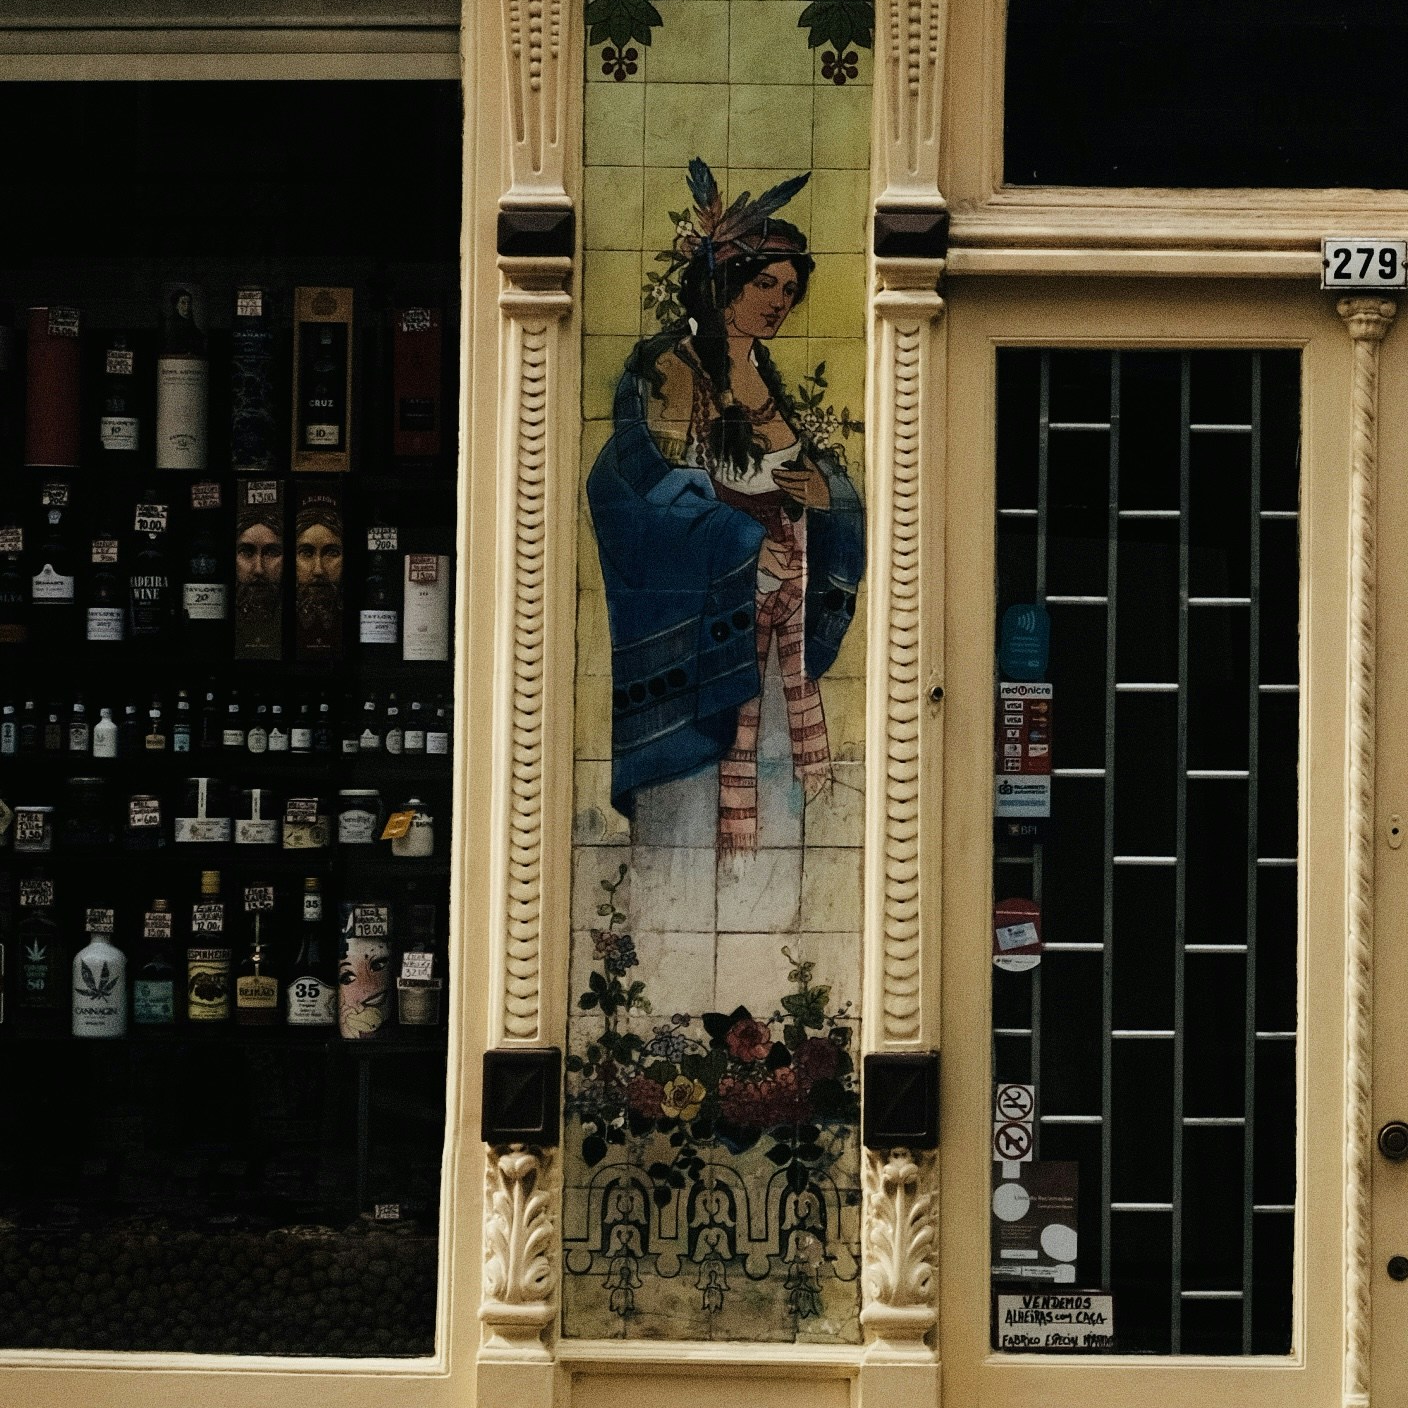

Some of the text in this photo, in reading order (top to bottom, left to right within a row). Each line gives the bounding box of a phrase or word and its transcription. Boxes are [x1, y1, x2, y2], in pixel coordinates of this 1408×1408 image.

[1334, 248, 1397, 279] 279
[309, 398, 335, 408] CRUZ
[133, 588, 161, 600] WINE
[196, 594, 208, 603] 20
[305, 900, 320, 908] 35
[295, 983, 321, 998] 35
[1022, 1295, 1092, 1309] VENDEMOS
[1005, 1309, 1053, 1327] ALHEIRAS
[1076, 1311, 1108, 1326] CAÇA
[1003, 1333, 1041, 1348] FABRICO
